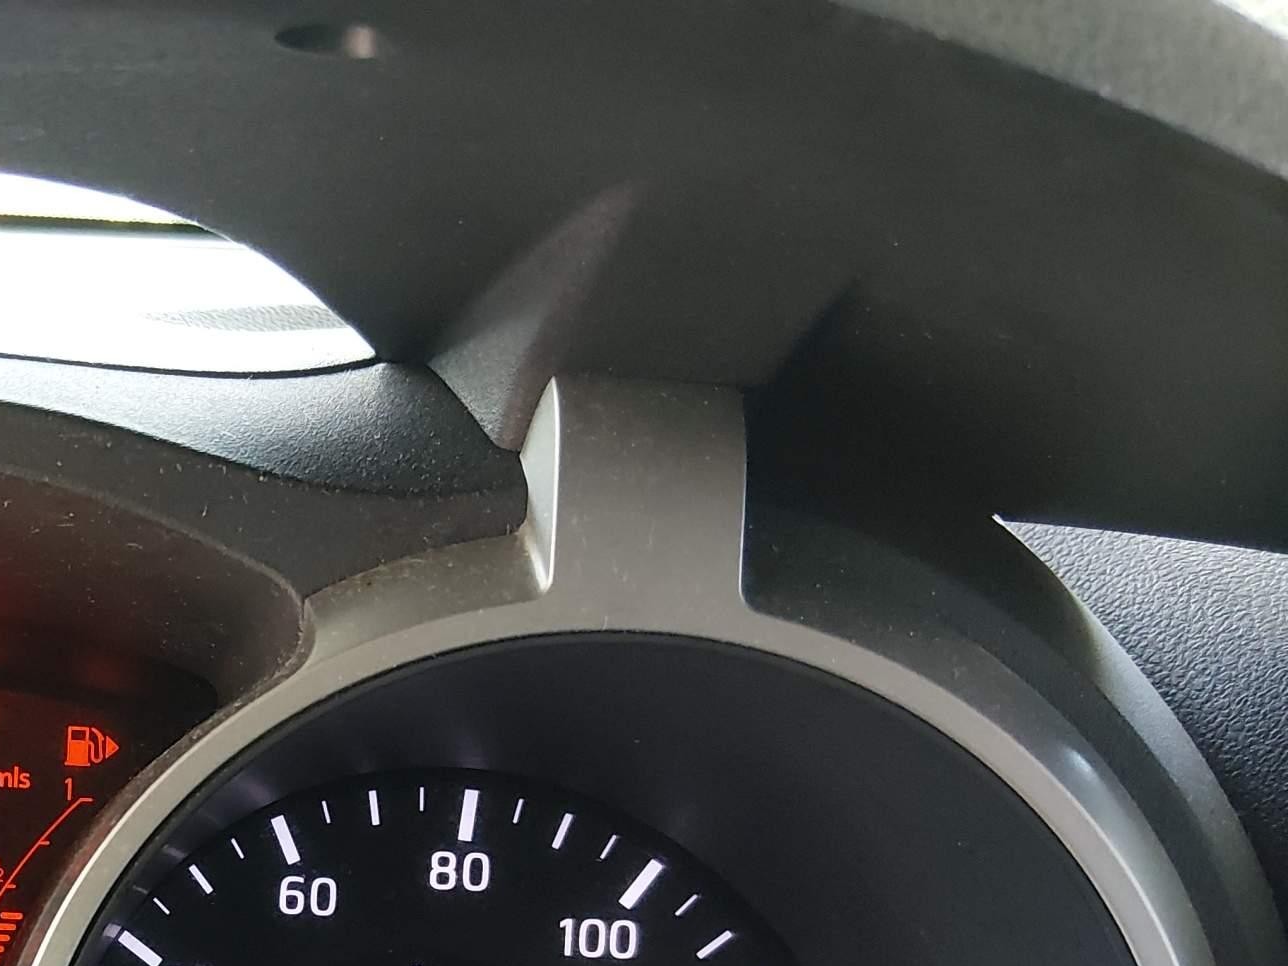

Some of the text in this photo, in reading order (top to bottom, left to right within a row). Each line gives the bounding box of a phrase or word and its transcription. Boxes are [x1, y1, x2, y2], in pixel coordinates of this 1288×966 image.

[63, 778, 74, 800] 1
[429, 850, 490, 892] 80
[278, 875, 337, 917] 60
[559, 918, 638, 960] 100
